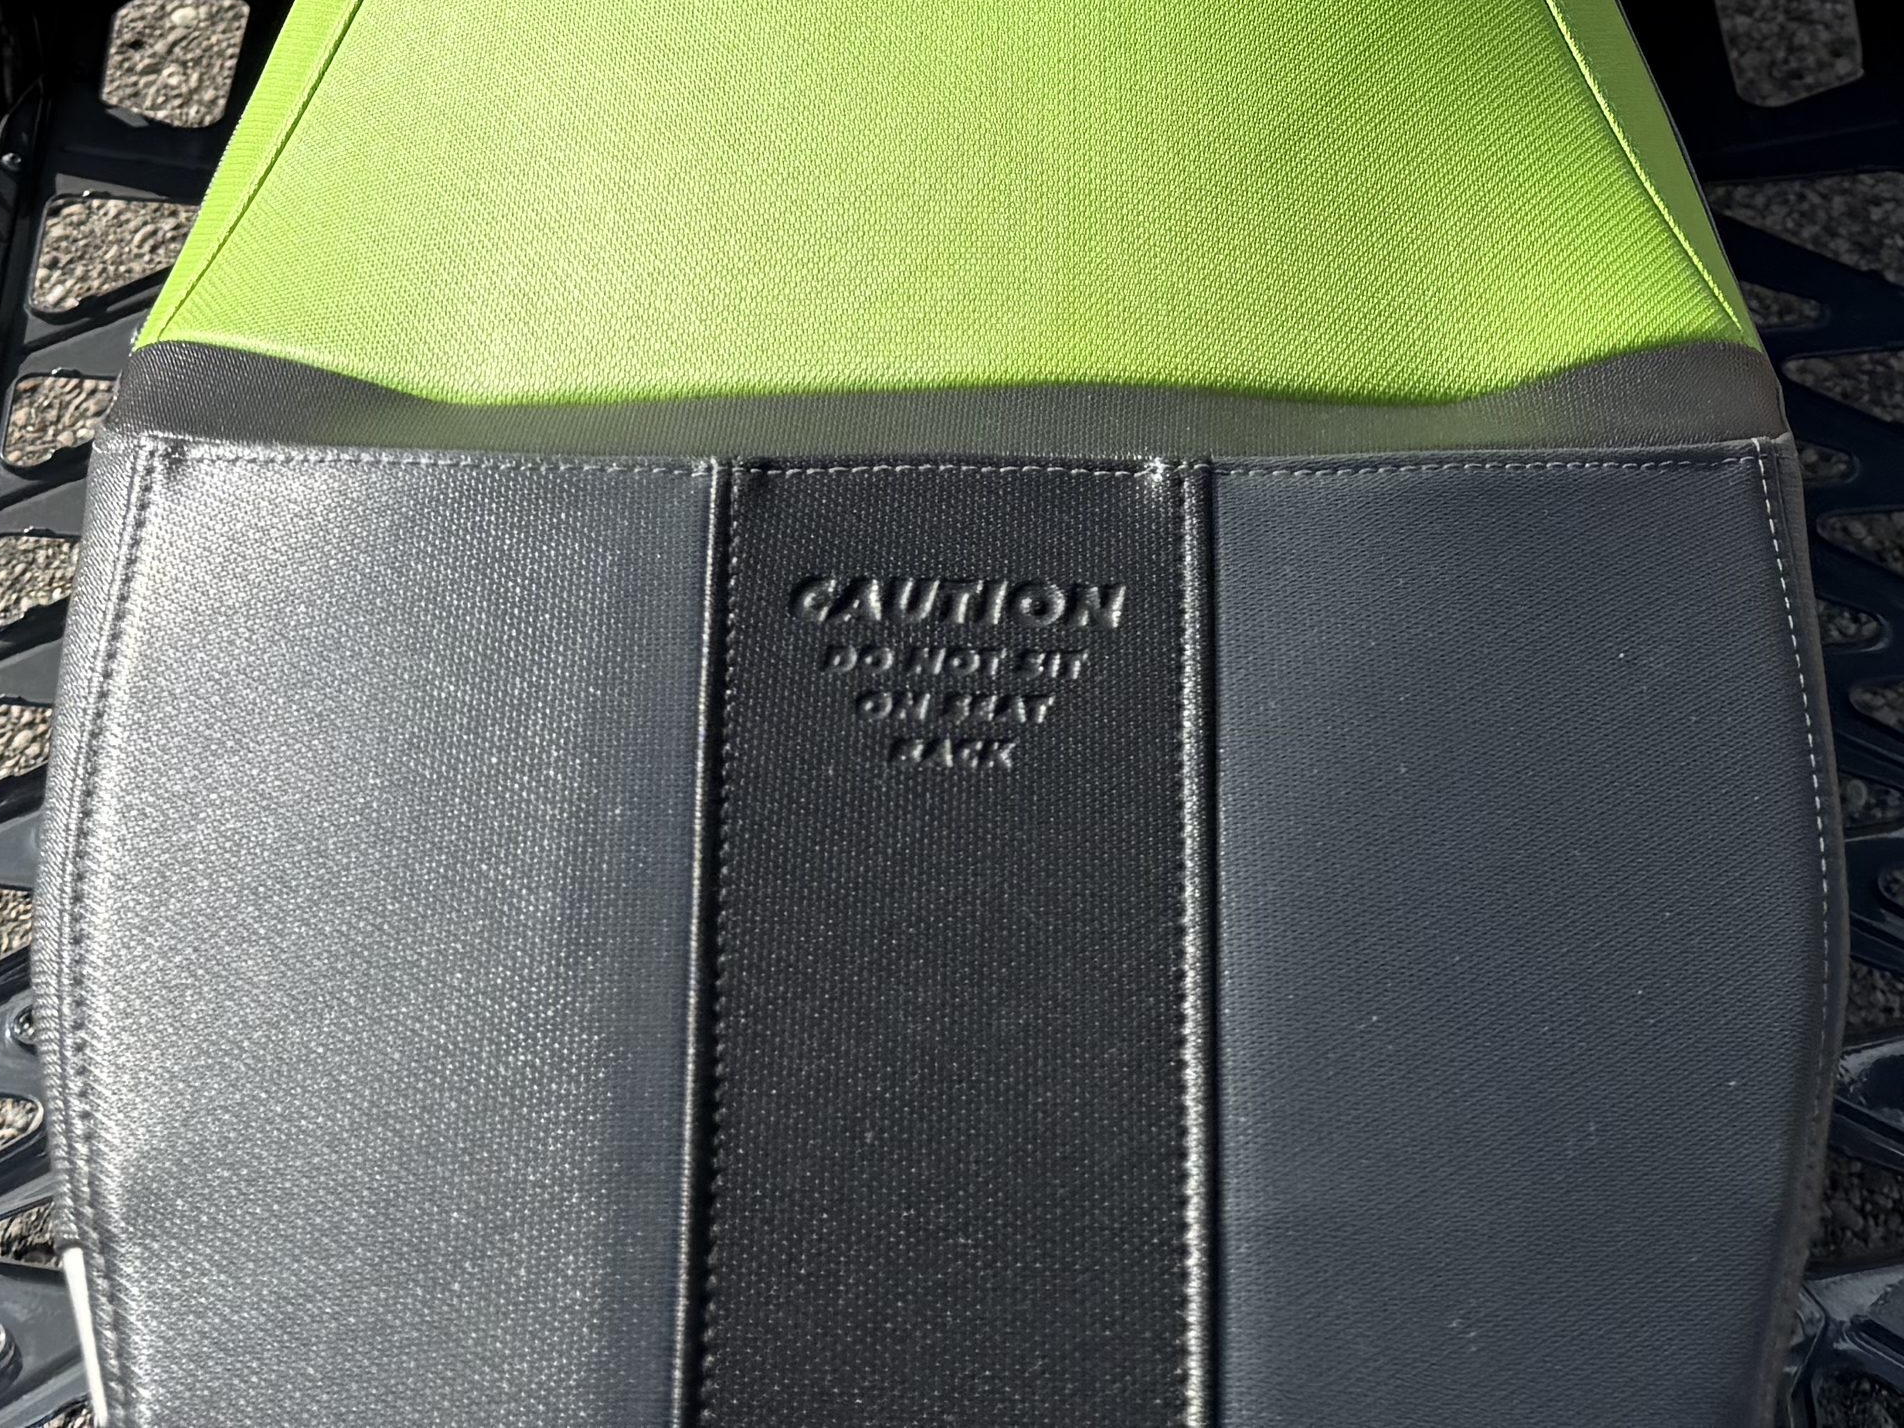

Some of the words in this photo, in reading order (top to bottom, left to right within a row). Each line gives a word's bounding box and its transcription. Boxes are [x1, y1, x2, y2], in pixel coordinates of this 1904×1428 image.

[789, 575, 1126, 630] CAUTION
[824, 644, 895, 674] DO
[905, 647, 1007, 677] NOT
[1014, 649, 1089, 680] SIT
[855, 690, 932, 722] ON
[938, 693, 1055, 724] SEAT
